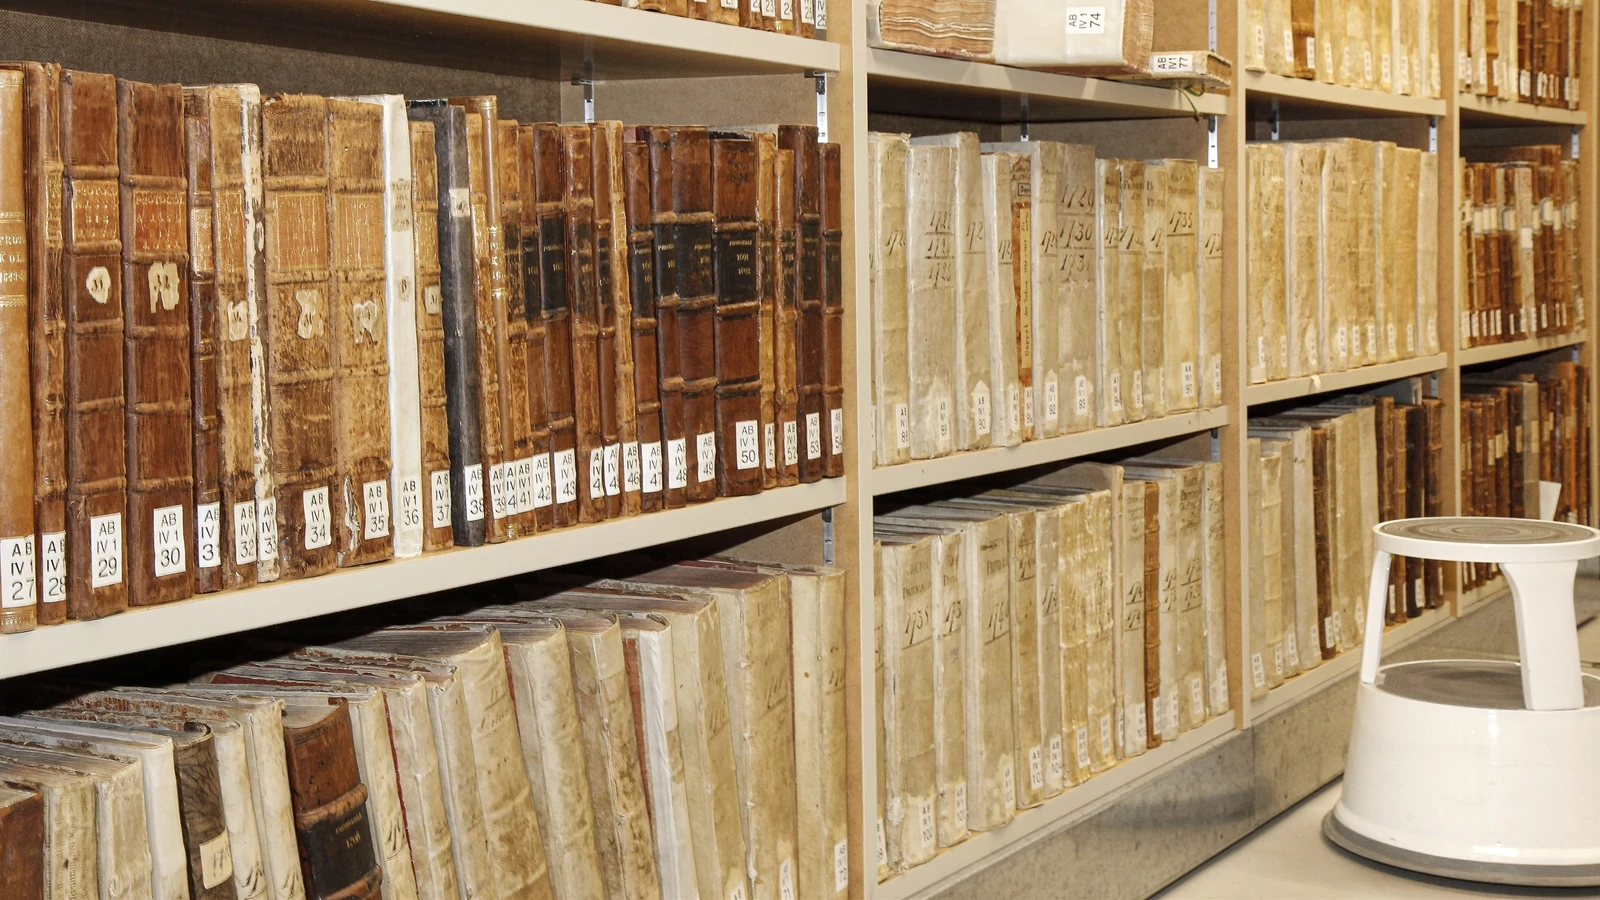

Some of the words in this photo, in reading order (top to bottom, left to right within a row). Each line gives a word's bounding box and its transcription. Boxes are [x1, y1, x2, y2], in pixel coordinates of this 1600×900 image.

[1069, 14, 1077, 27] AB
[1079, 20, 1087, 29] IV
[1090, 12, 1101, 28] 74
[1158, 57, 1166, 70] AB
[1168, 61, 1177, 70] IV
[1179, 56, 1188, 69] 77
[787, 423, 795, 433] AB
[810, 417, 818, 427] AB
[741, 425, 754, 435] AB
[703, 436, 713, 447] AB
[740, 437, 748, 447] IV
[751, 437, 755, 446] 1
[787, 435, 793, 444] IV
[627, 446, 637, 458] AB
[650, 446, 661, 457] AB
[787, 446, 797, 461] 52
[810, 440, 819, 454] 53
[562, 453, 573, 465] AB
[702, 449, 709, 460] IV
[741, 449, 756, 464] 50
[769, 450, 774, 462] 5
[536, 458, 548, 470] AB
[607, 462, 616, 473] IV
[626, 460, 634, 470] IV
[634, 458, 638, 469] 1
[648, 459, 658, 470] IV
[674, 456, 683, 467] IV
[493, 468, 503, 481] AB
[518, 463, 530, 475] AB
[561, 469, 570, 480] IV
[592, 466, 601, 476] IV
[676, 468, 687, 482] 48
[703, 461, 714, 476] 49
[436, 474, 449, 486] AB
[518, 477, 527, 489] IV
[527, 476, 531, 487] 1
[535, 473, 544, 484] IV
[592, 478, 601, 492] 4
[627, 471, 639, 486] 46
[649, 471, 662, 486] 47
[369, 486, 382, 499] AB
[402, 480, 416, 493] AB
[468, 484, 478, 497] IV
[493, 484, 501, 495] IV
[506, 480, 516, 492] IV
[563, 481, 576, 497] 43
[435, 490, 444, 501] IV
[520, 490, 531, 506] 41
[537, 485, 551, 501] 42
[310, 493, 324, 507] AB
[403, 496, 411, 508] IV
[413, 494, 417, 506] 1
[470, 498, 484, 515] 38
[495, 496, 506, 514] 39
[507, 494, 518, 509] 4
[241, 506, 253, 521] AB
[263, 504, 274, 518] AB
[369, 501, 377, 514] IV
[379, 501, 383, 512] 1
[436, 504, 450, 521] 37
[161, 513, 177, 528] AB
[311, 509, 320, 522] IV
[321, 508, 326, 520] 1
[403, 509, 419, 526] 36
[99, 520, 116, 537] AB
[240, 524, 249, 537] IV
[251, 522, 255, 534] 1
[261, 521, 271, 533] IV
[370, 515, 385, 533] 35
[159, 531, 169, 545] IV
[174, 530, 179, 542] 1
[201, 526, 214, 539] IV
[310, 524, 326, 544] 34
[12, 541, 32, 558] AB
[96, 540, 108, 554] IV
[113, 539, 117, 551] 1
[240, 539, 254, 558] 32
[161, 547, 181, 568] 30
[11, 562, 25, 576] IV
[30, 558, 34, 572] 1
[46, 559, 60, 573] IV
[98, 557, 117, 579] 29
[12, 578, 34, 601] 27
[48, 576, 66, 597] 28
